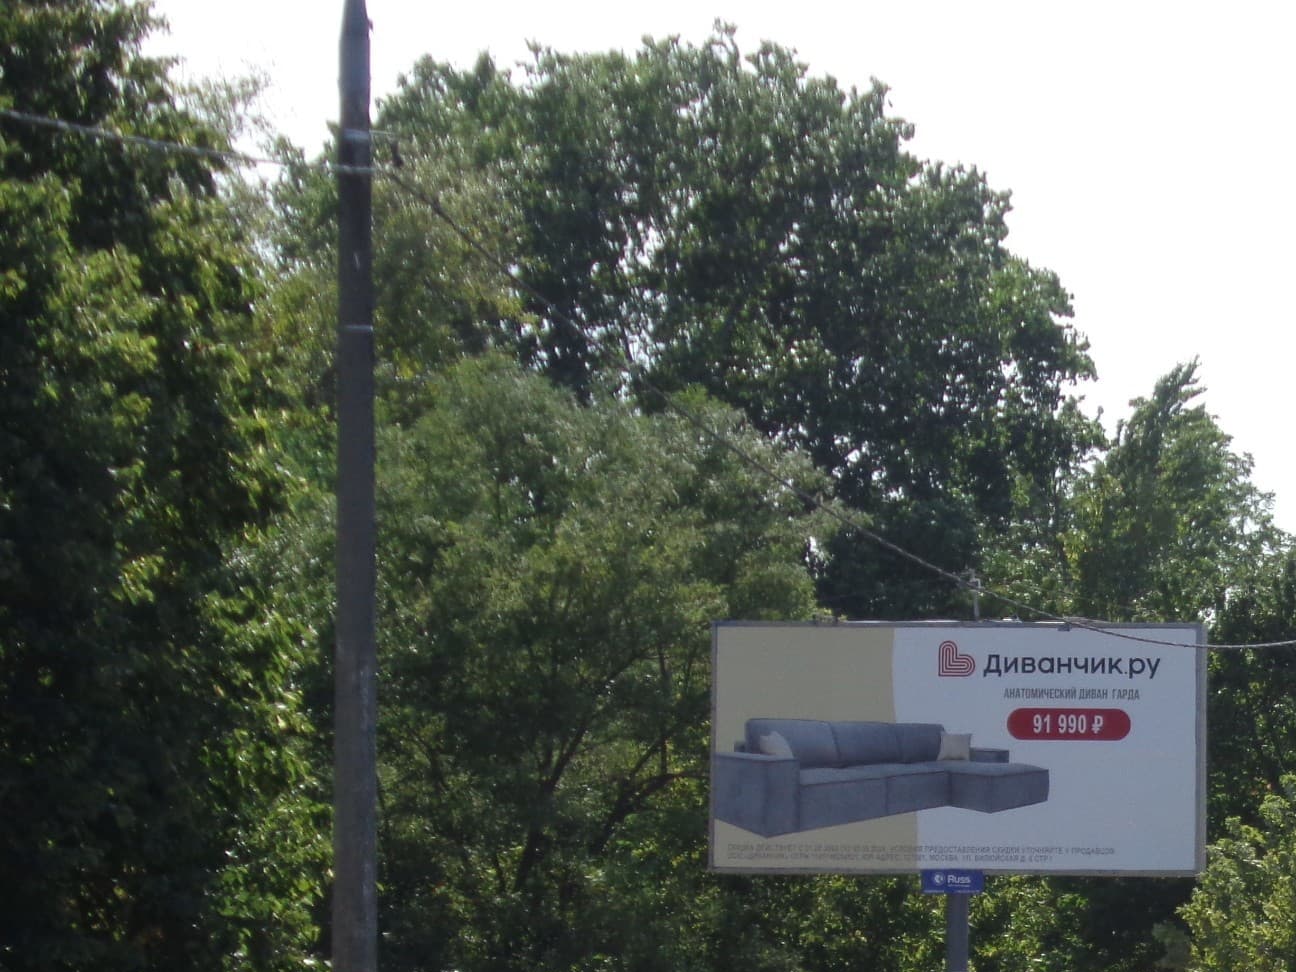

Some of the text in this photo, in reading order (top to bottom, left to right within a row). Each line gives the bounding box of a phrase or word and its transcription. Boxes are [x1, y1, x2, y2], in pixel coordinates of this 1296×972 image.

[983, 654, 1161, 680] Диванчик.ру
[1004, 686, 1140, 700] АНАТОМИЧЕСКИЙ ДИВАН ГАРДА
[1033, 714, 1051, 734] 91
[1058, 714, 1087, 734] 990
[947, 874, 971, 884] Russ
